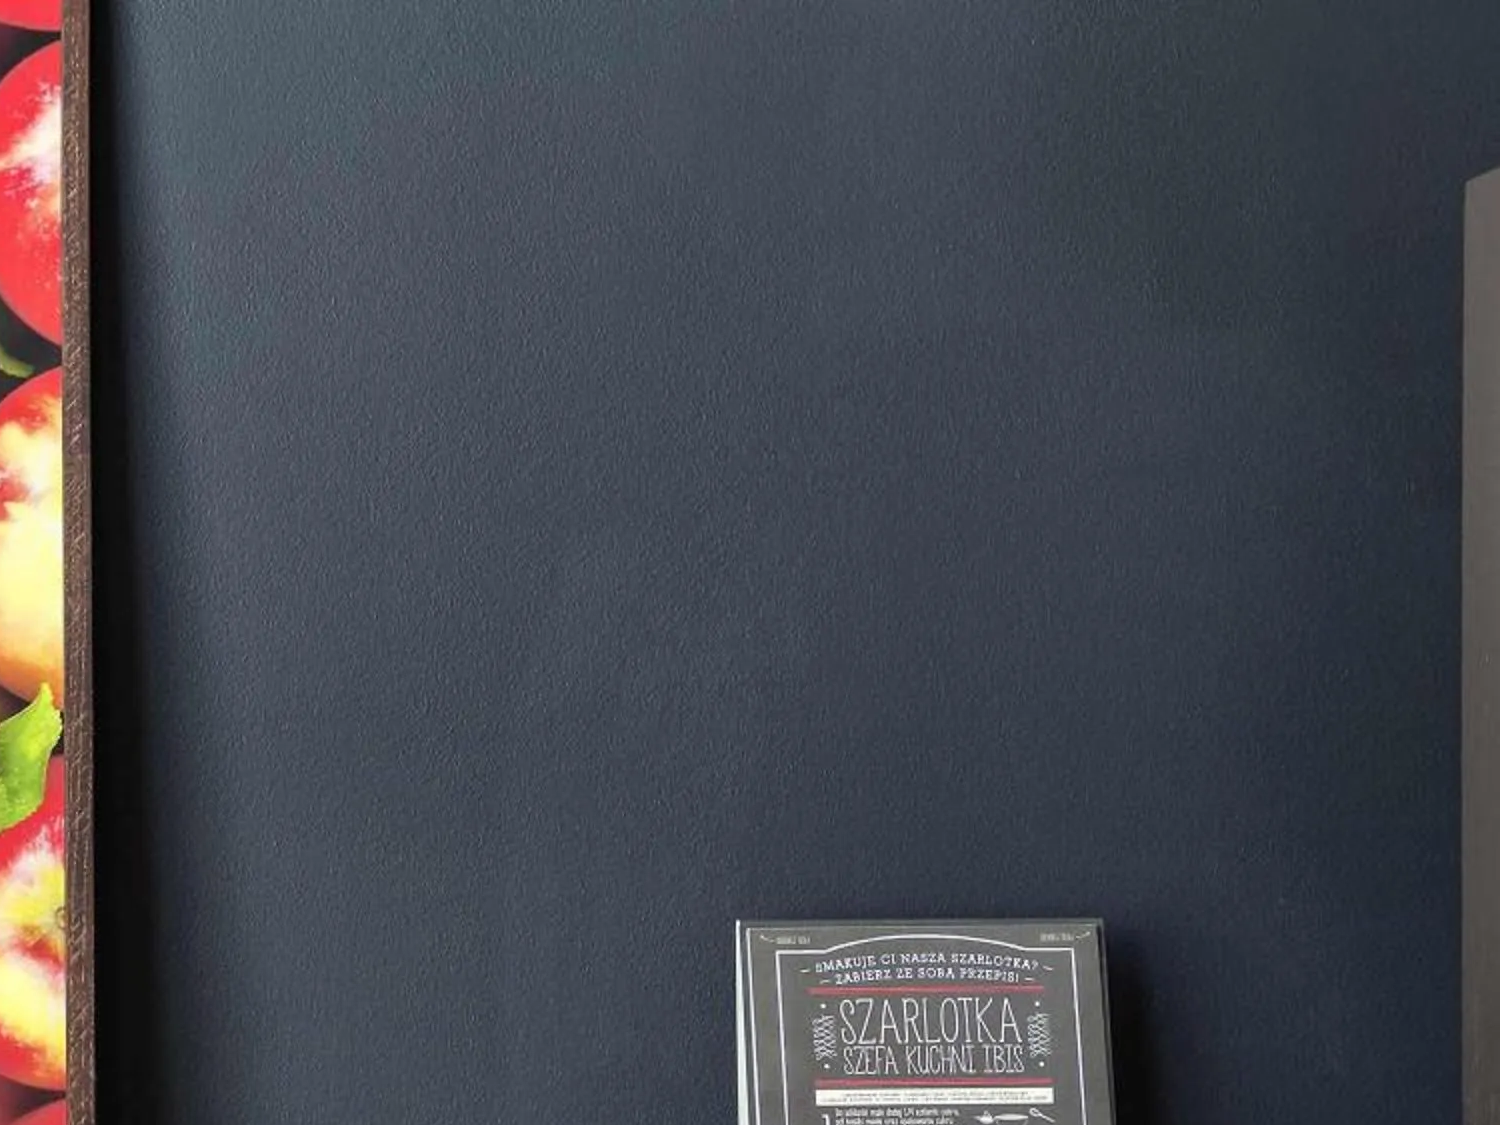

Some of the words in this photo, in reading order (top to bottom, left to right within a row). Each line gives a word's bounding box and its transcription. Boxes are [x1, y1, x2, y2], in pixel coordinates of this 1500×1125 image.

[815, 956, 877, 974] SMAKUJE
[881, 954, 897, 966] CI
[902, 953, 946, 965] NASZA
[836, 970, 892, 986] ZABIERZ
[897, 969, 913, 980] ZE
[839, 997, 1024, 1045] SZARLOTKA
[843, 1045, 900, 1075] SZEFA
[906, 1044, 977, 1074] KUCHNI
[983, 1043, 1026, 1073] IBIS
